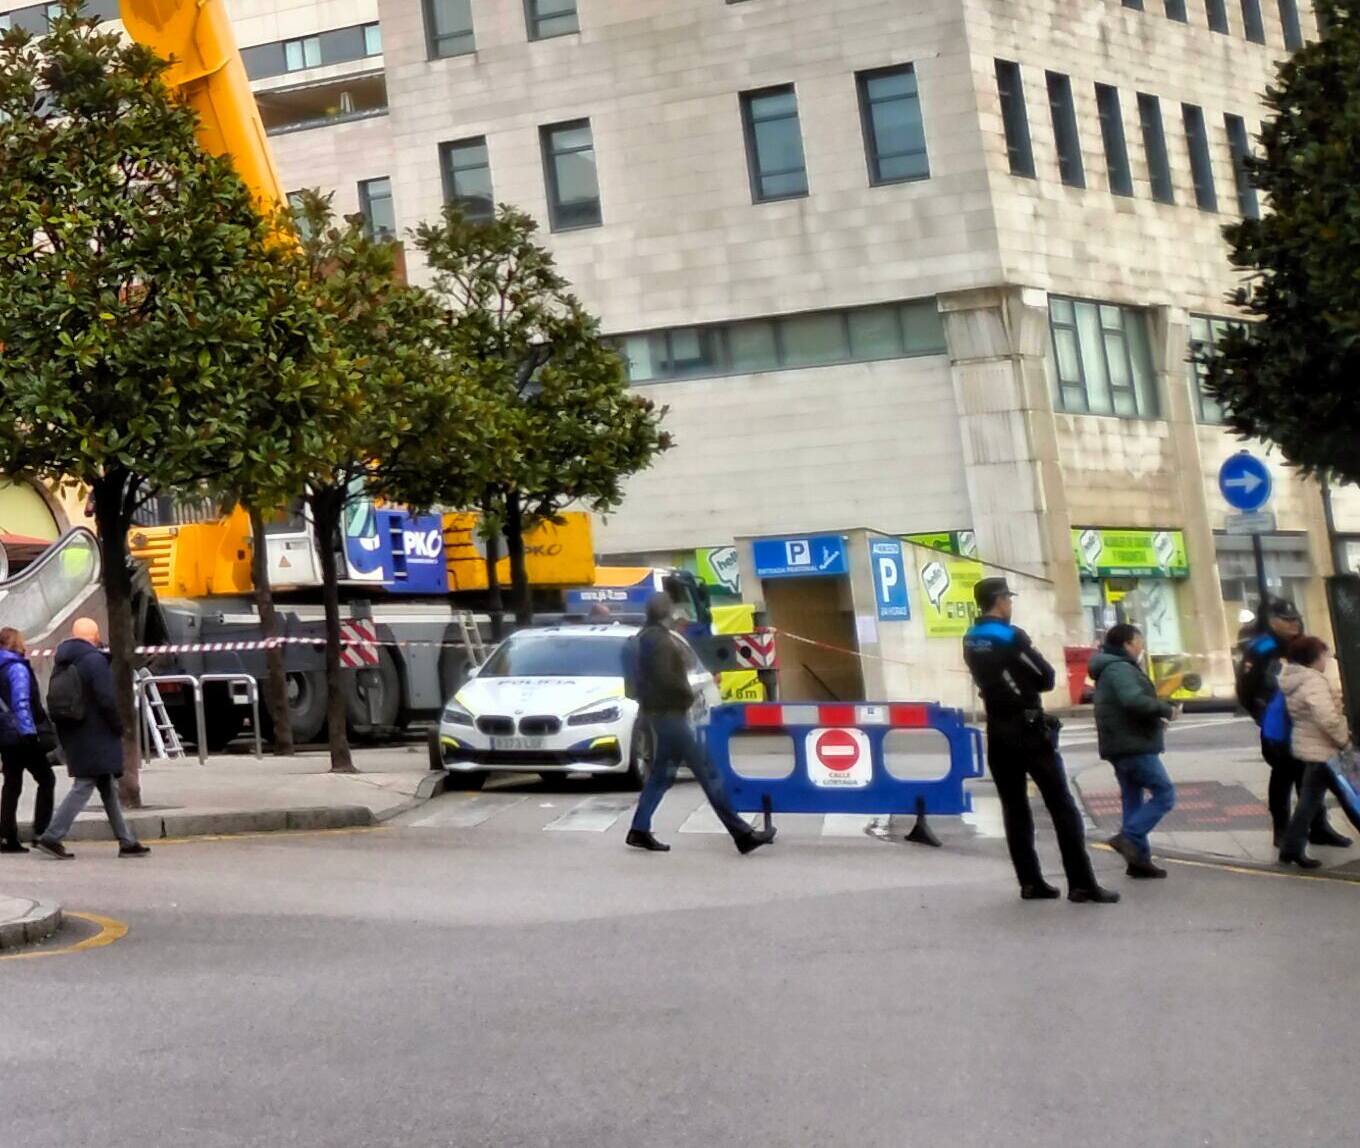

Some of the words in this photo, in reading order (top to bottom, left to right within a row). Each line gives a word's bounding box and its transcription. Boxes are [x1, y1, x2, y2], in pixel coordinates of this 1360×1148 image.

[403, 529, 443, 558] PKO
[790, 543, 804, 563] P
[879, 557, 898, 603] P
